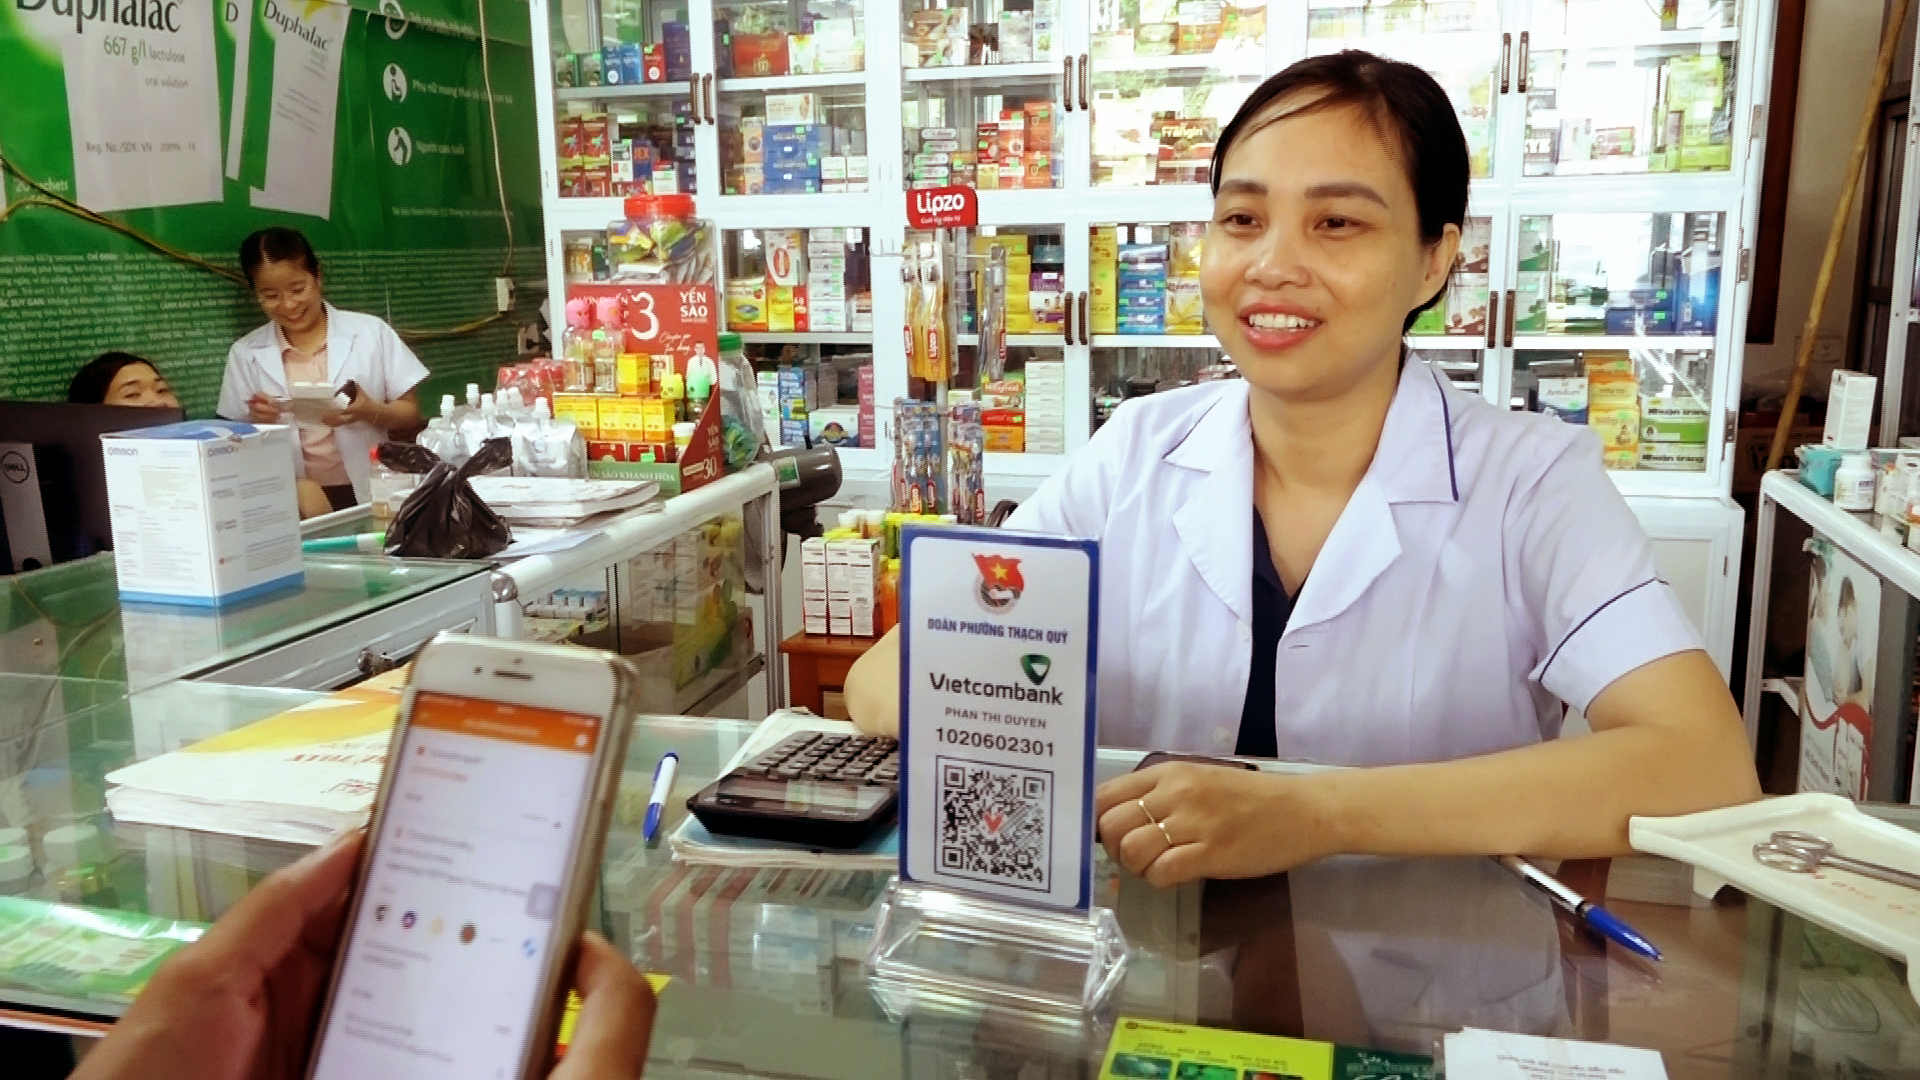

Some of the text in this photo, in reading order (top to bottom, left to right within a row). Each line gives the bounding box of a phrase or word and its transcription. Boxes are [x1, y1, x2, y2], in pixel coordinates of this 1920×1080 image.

[17, 0, 182, 33] uphalac
[264, 0, 330, 51] Duphalac
[104, 35, 127, 56] 667
[131, 39, 147, 65] g/l
[916, 191, 965, 216] Lipzo
[631, 290, 660, 341] 3
[703, 456, 717, 480] 30
[927, 617, 957, 632] ĐOÀN
[960, 620, 1004, 638] PHƯỜNG
[1008, 626, 1043, 642] THẠCH
[929, 672, 1064, 706] Vietcombank
[945, 706, 1047, 729] PHAN THI DUYEN
[936, 726, 1054, 758] 1020602301
